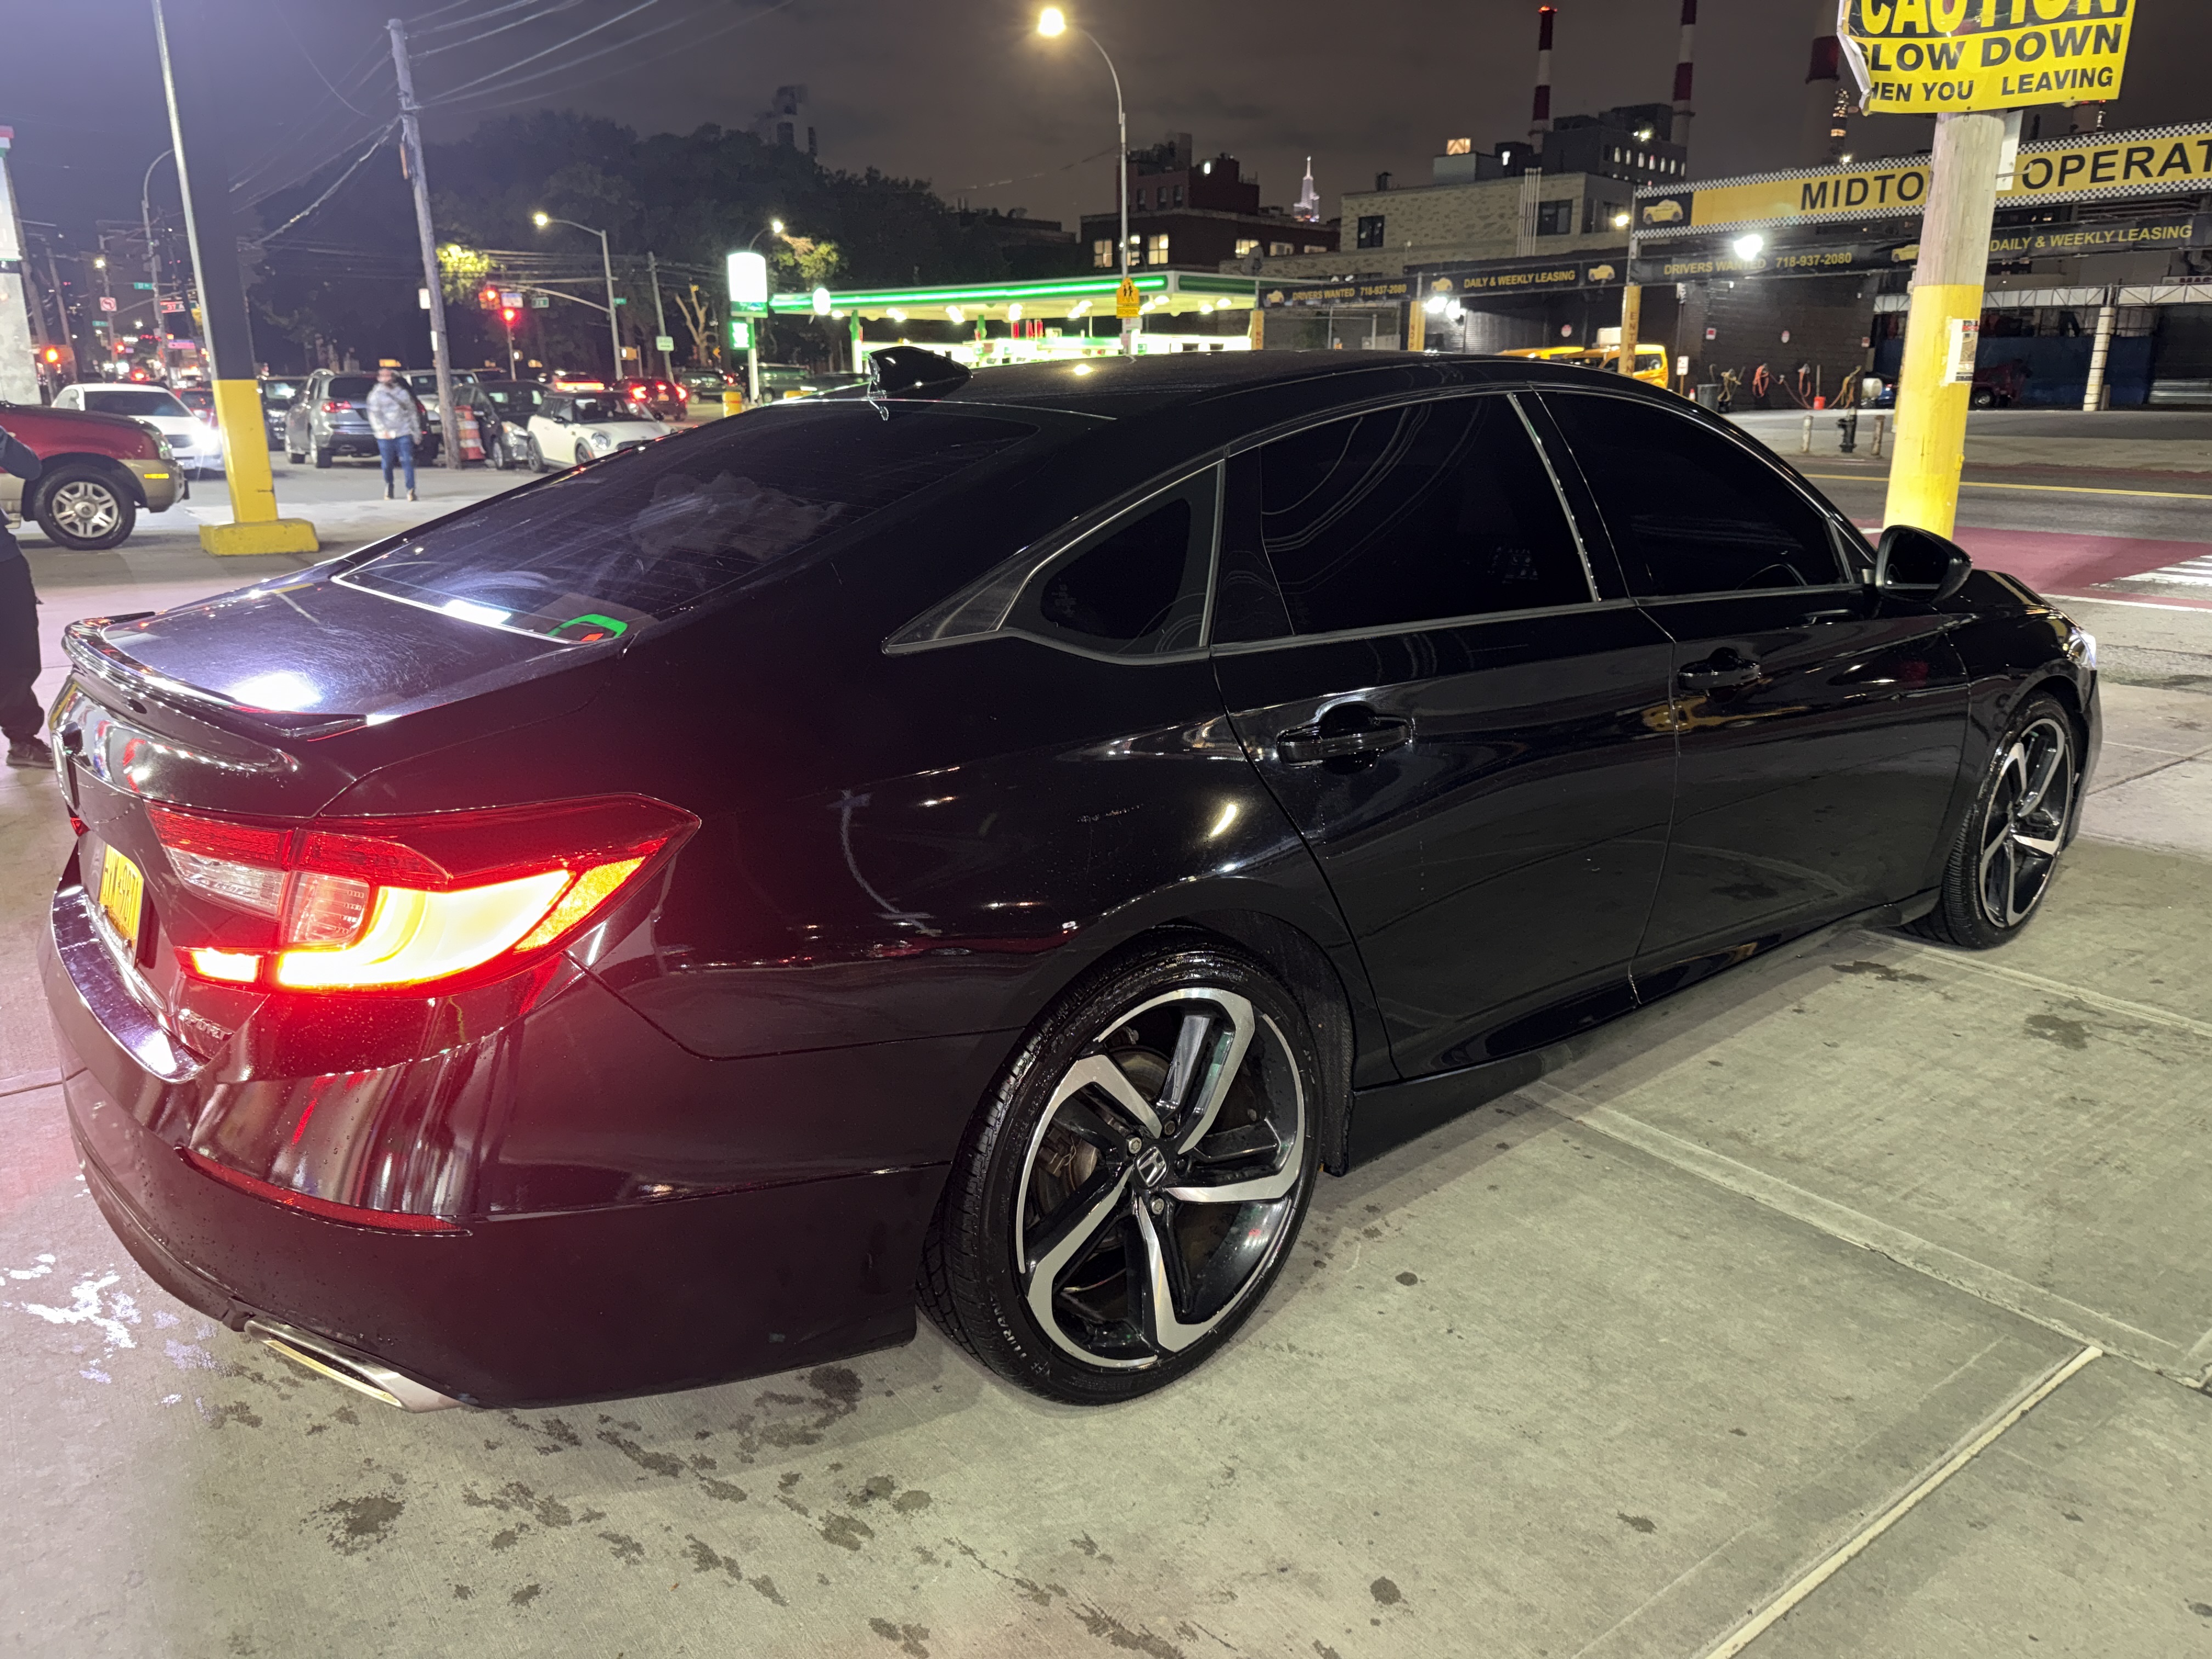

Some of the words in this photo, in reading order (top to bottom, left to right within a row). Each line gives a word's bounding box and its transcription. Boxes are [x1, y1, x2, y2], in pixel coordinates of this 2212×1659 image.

[1980, 24, 2123, 68] DOWN
[1871, 82, 1913, 102] HEN
[1922, 80, 1974, 101] YOU
[2001, 66, 2114, 96] LEAVING
[1800, 171, 1925, 211] MIDTO
[1990, 238, 2031, 252] DAILY
[2034, 235, 2046, 249] &
[2050, 230, 2115, 247] WEEKLY
[2118, 224, 2193, 242] LEASING
[1464, 277, 1488, 289] DAILY
[1489, 276, 1496, 286] &
[1498, 273, 1536, 286] WEEKLY
[1535, 270, 1576, 283] LEASING
[1664, 262, 1713, 275] DRIVERS
[1776, 252, 1852, 268] 718-937-2080
[1626, 312, 1638, 374] ENTRAN
